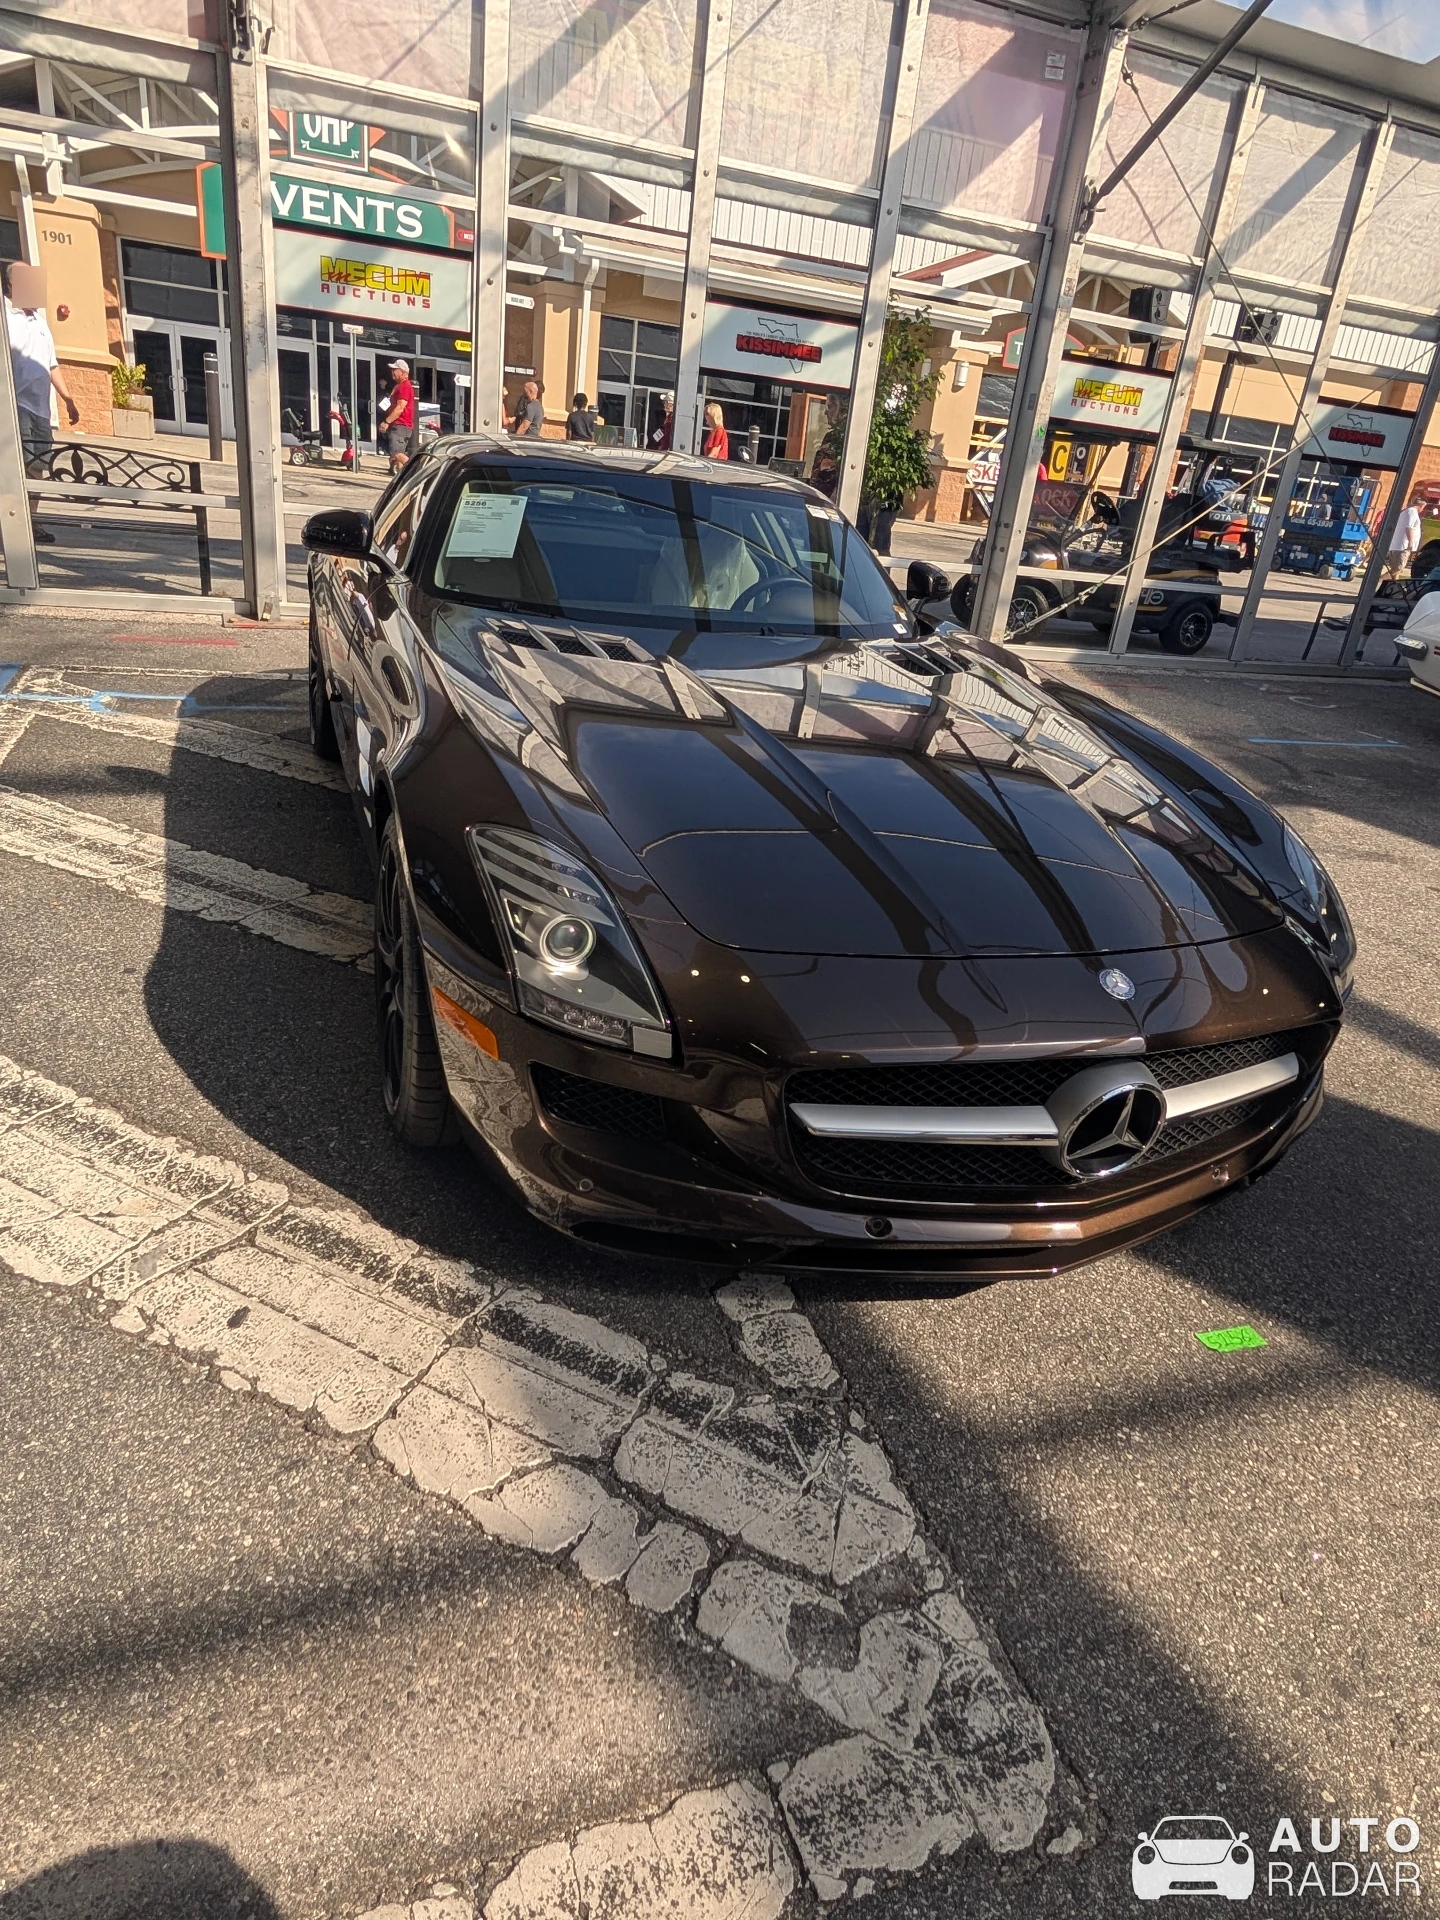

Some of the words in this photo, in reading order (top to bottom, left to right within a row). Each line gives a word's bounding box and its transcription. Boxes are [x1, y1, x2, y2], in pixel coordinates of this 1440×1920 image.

[270, 181, 423, 238] VENTS
[42, 230, 72, 245] 1901
[320, 255, 431, 298] MECUM
[321, 283, 431, 309] AUCTIONS
[736, 334, 822, 363] KISSIMMEE
[1073, 378, 1143, 407] MECUM
[1071, 398, 1138, 416] AUCTIONS
[1209, 511, 1232, 521] YOTA
